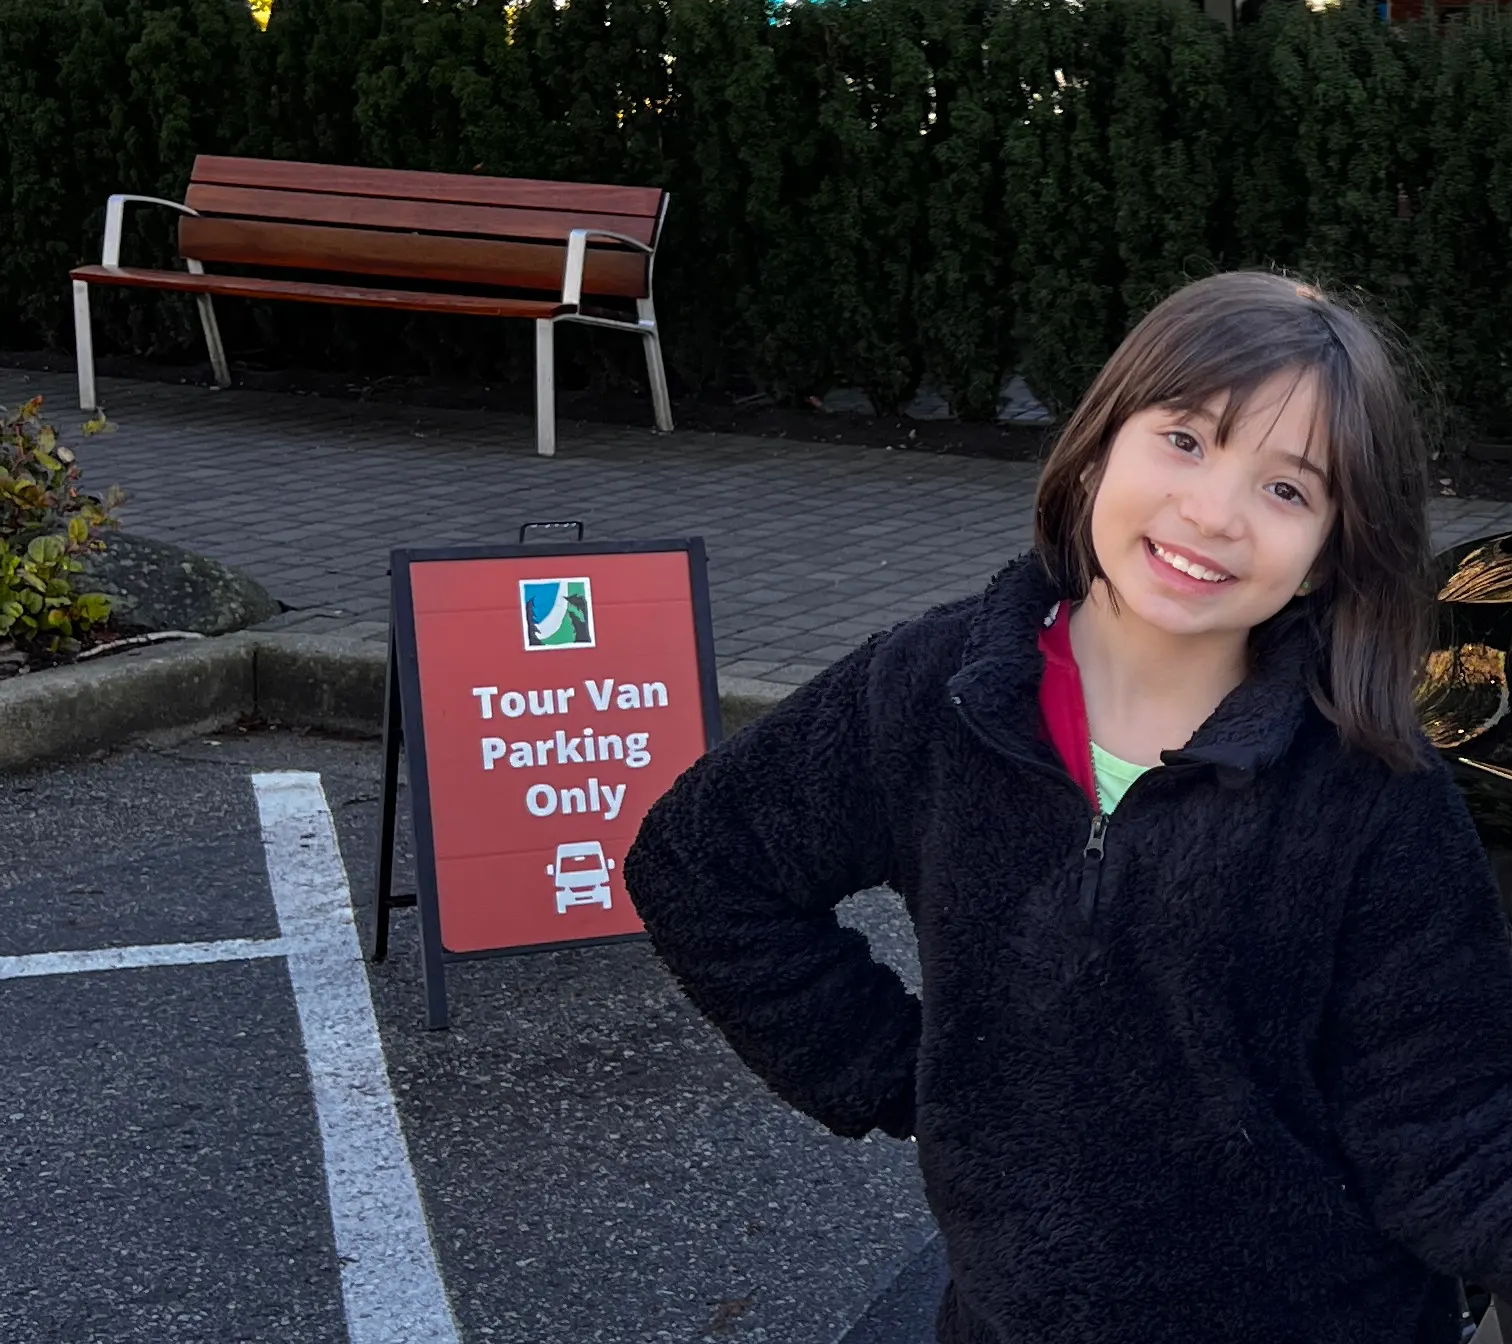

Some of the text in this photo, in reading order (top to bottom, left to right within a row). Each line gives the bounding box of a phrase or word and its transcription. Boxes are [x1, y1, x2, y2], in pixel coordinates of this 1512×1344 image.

[472, 678, 669, 720] Tour Van
[481, 727, 652, 770] Parking
[525, 777, 627, 821] Only
